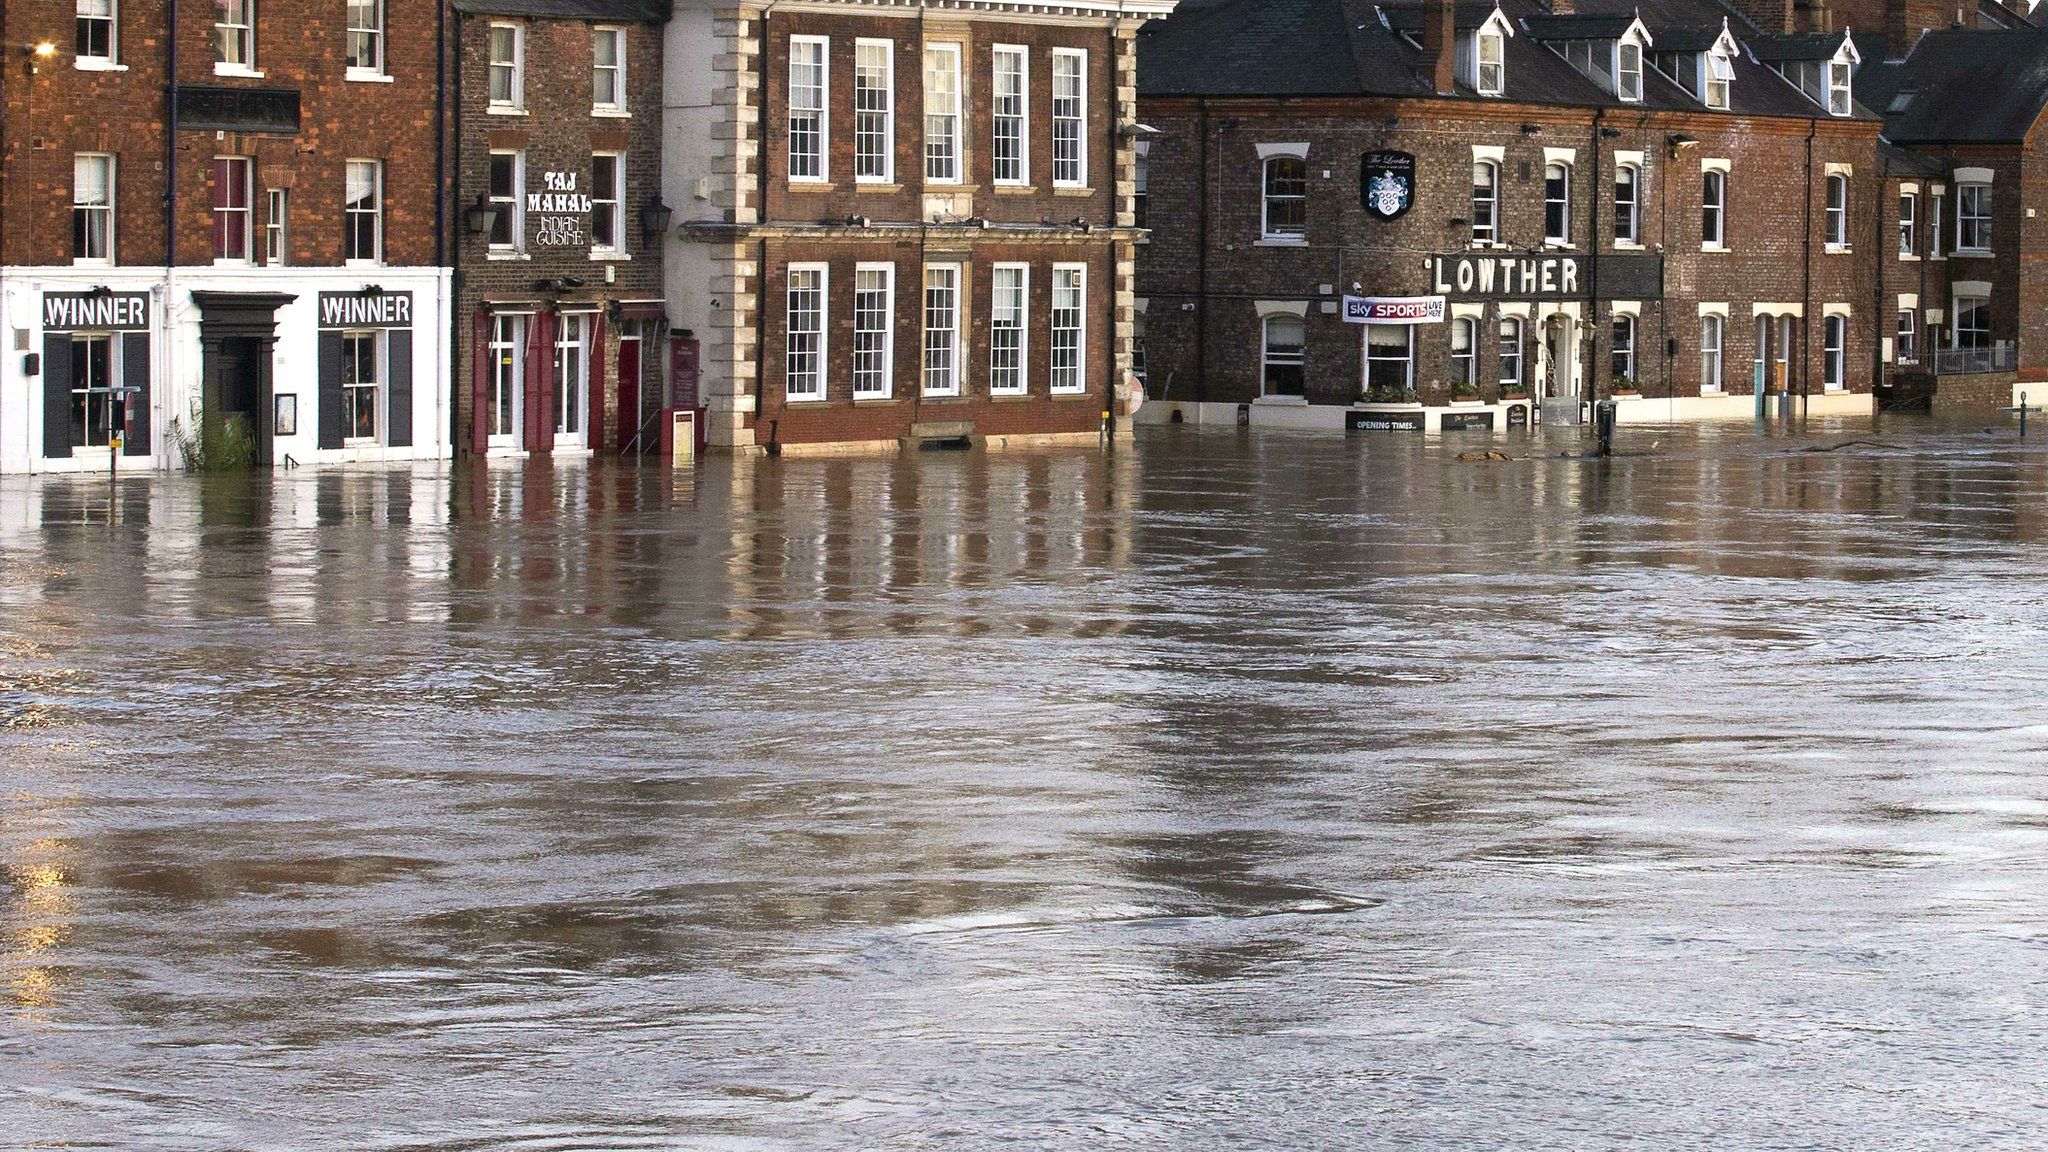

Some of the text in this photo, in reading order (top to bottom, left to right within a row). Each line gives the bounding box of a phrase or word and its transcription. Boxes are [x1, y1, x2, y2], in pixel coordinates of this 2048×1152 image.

[544, 171, 577, 191] TAJ
[527, 193, 592, 213] MAHAL
[541, 216, 580, 231] INDIAN
[536, 230, 584, 246] CUISINE
[1435, 257, 1578, 294] LOWTHER
[44, 297, 145, 326] WINNER
[322, 296, 410, 324] WINNER
[1350, 303, 1427, 317] sky SPORTS
[1428, 301, 1443, 309] LIVE
[1428, 309, 1442, 318] HERE
[1357, 421, 1390, 429] OPENING
